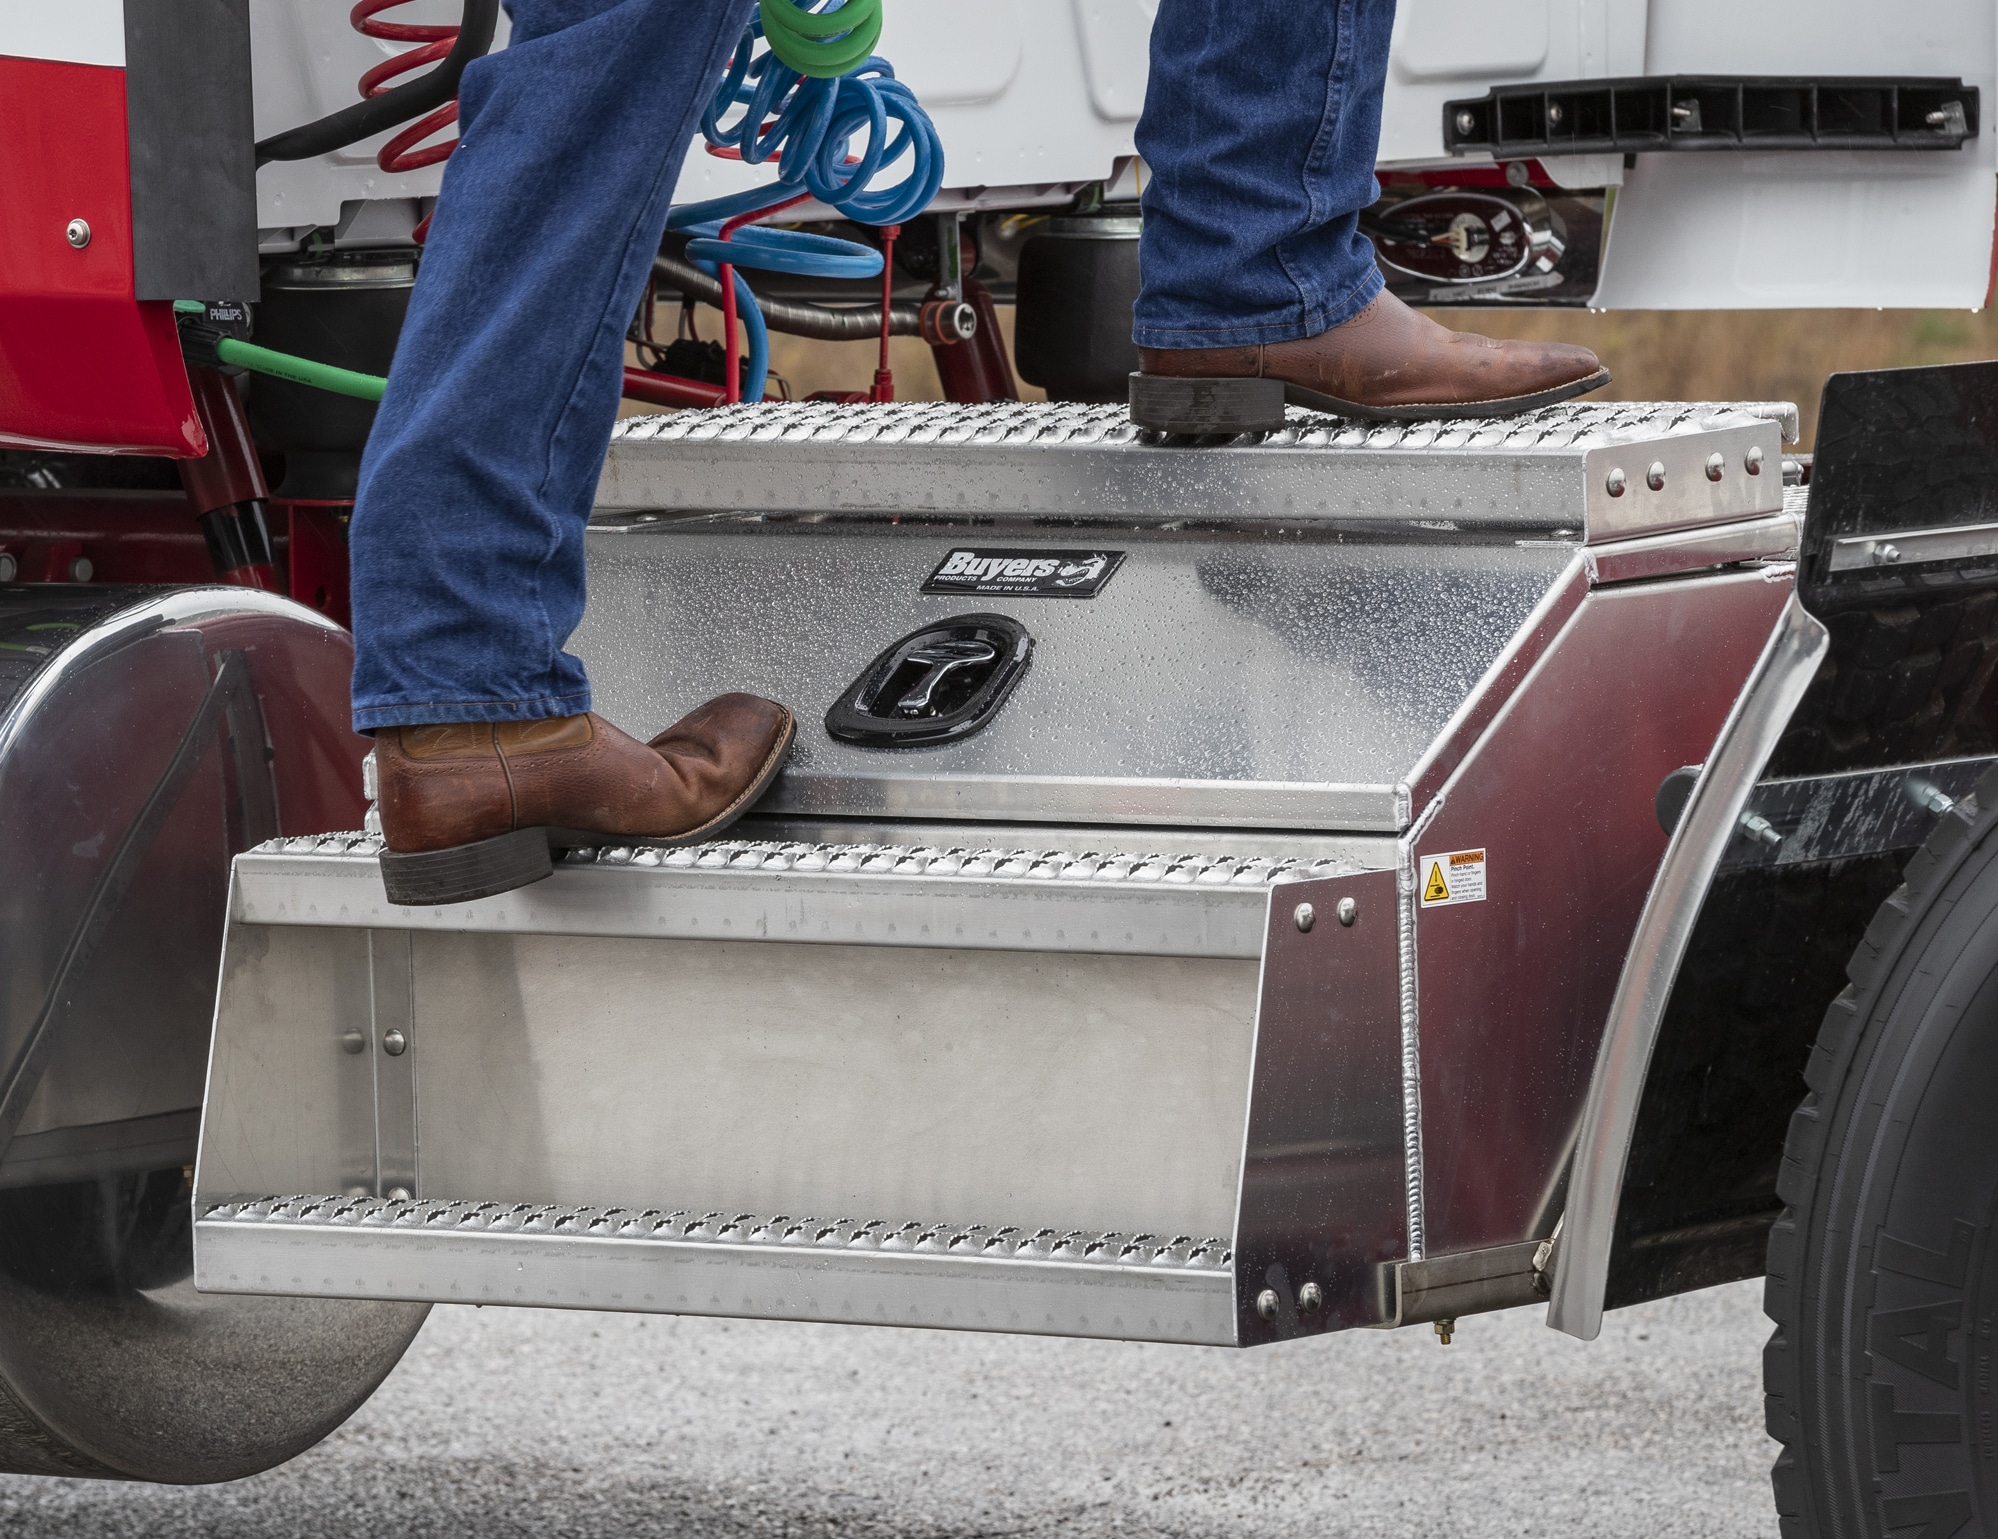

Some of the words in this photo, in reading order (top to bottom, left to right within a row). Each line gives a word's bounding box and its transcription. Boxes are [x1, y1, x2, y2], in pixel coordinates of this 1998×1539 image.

[210, 308, 242, 320] PHILLIPS
[938, 552, 1061, 581] Buyers
[1455, 853, 1484, 863] WARNING
